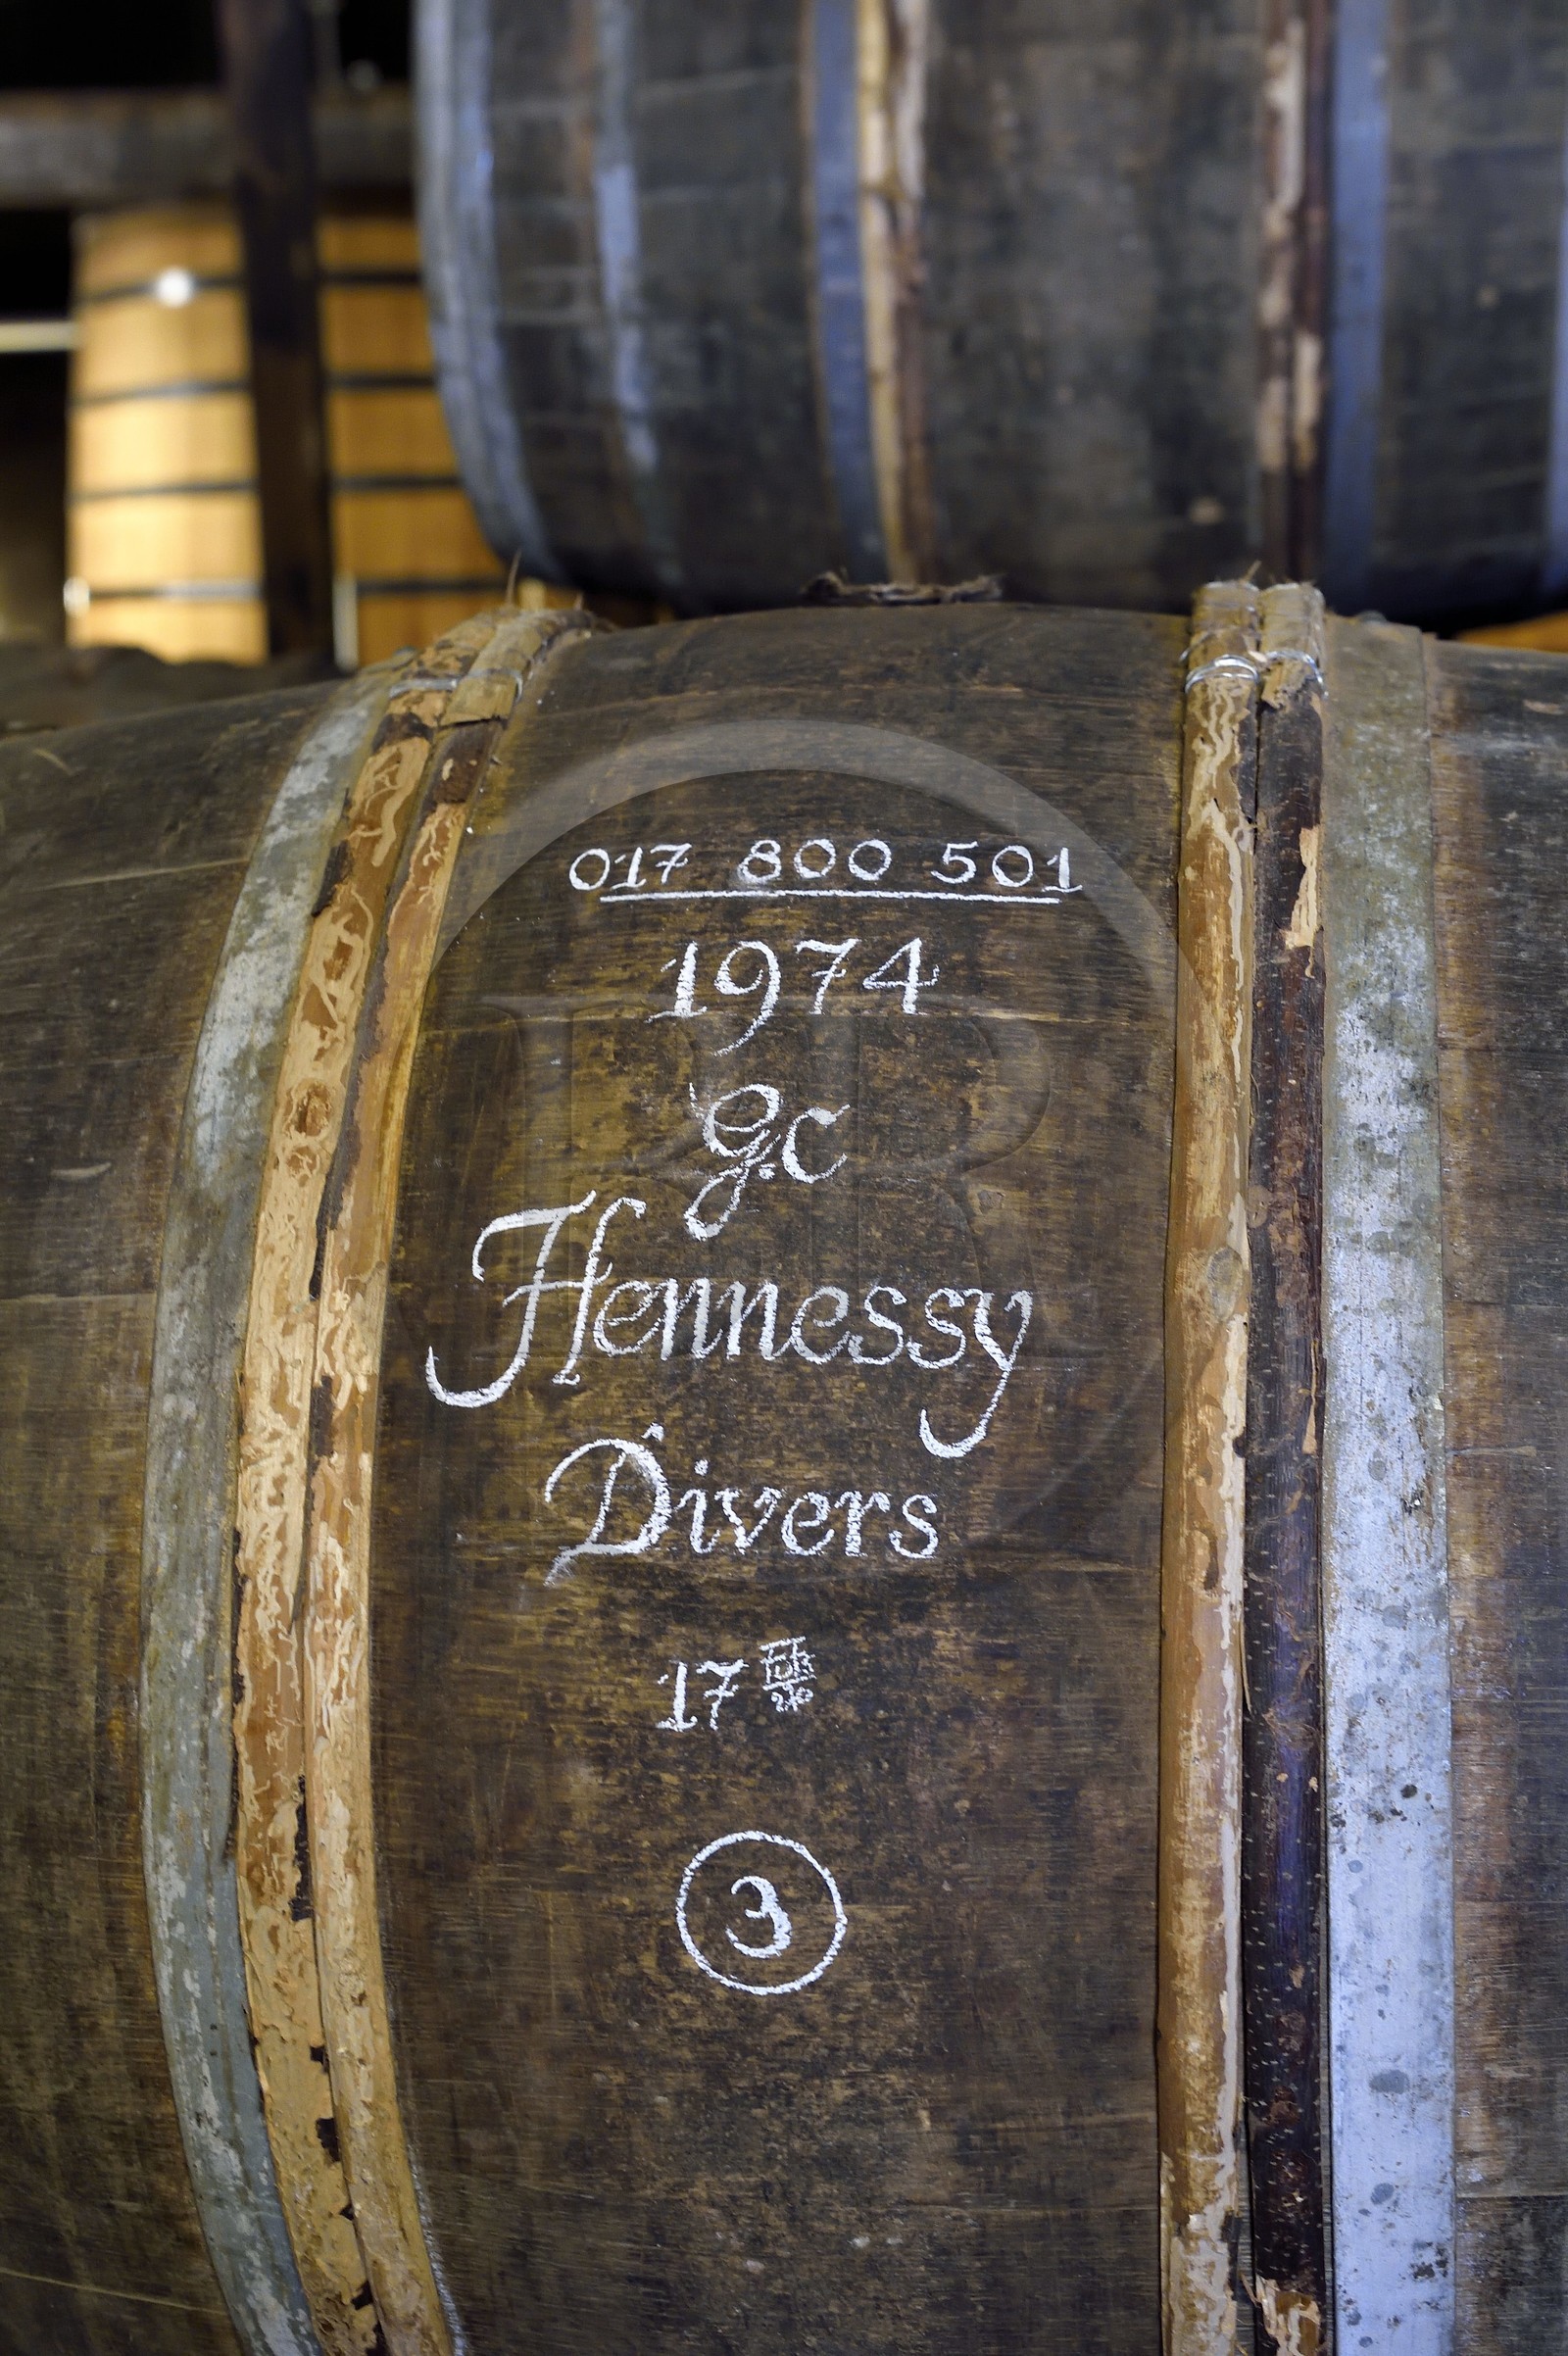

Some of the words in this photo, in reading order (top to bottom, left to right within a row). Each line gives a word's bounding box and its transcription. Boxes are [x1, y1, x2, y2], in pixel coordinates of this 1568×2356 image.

[569, 842, 692, 891] 017
[737, 838, 892, 883] 800
[931, 840, 1083, 892] 501
[644, 936, 939, 1057] 1974
[425, 1190, 1032, 1458] Hennessy
[544, 1423, 938, 1587] Divers
[656, 1658, 749, 1733] 17
[725, 1875, 793, 1958] 3
